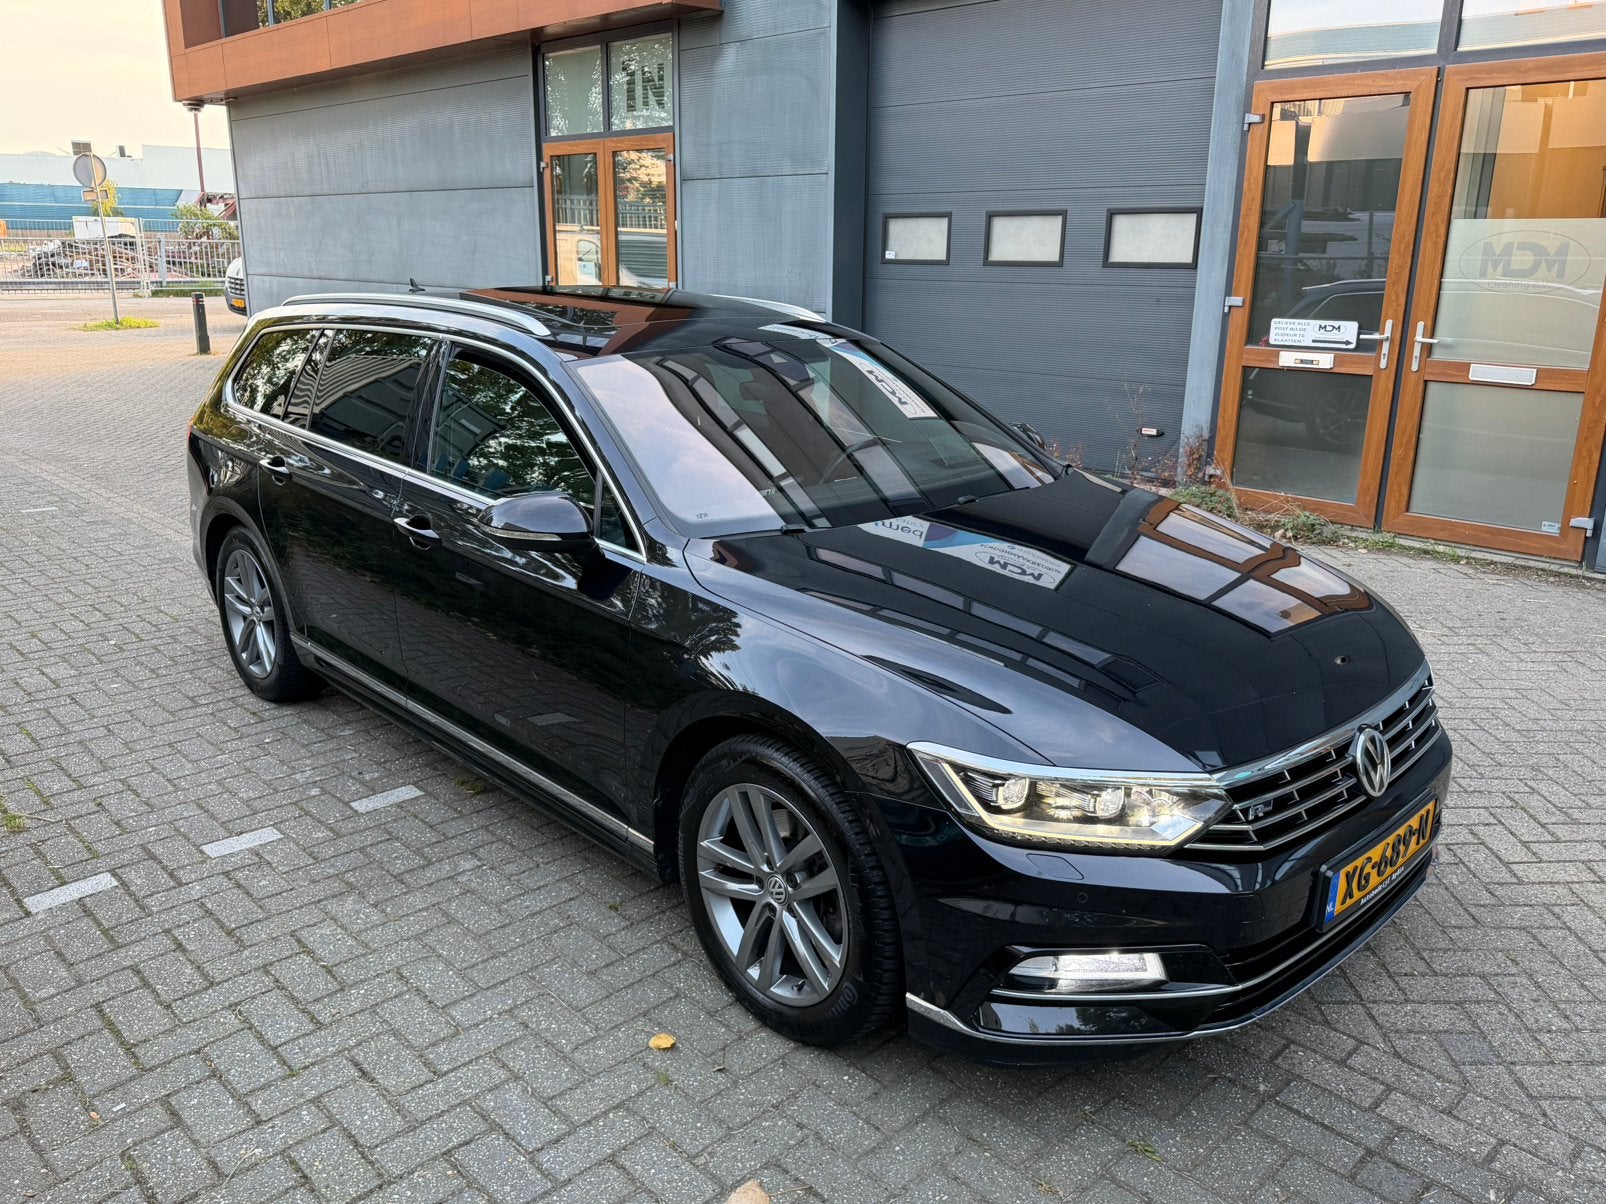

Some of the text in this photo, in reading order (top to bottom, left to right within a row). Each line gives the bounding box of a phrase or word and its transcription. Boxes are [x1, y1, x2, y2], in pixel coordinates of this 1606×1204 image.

[1478, 241, 1570, 279] MDM
[1318, 324, 1341, 333] MDM
[1340, 808, 1431, 906] XG-689-N
[1326, 901, 1334, 915] NL
